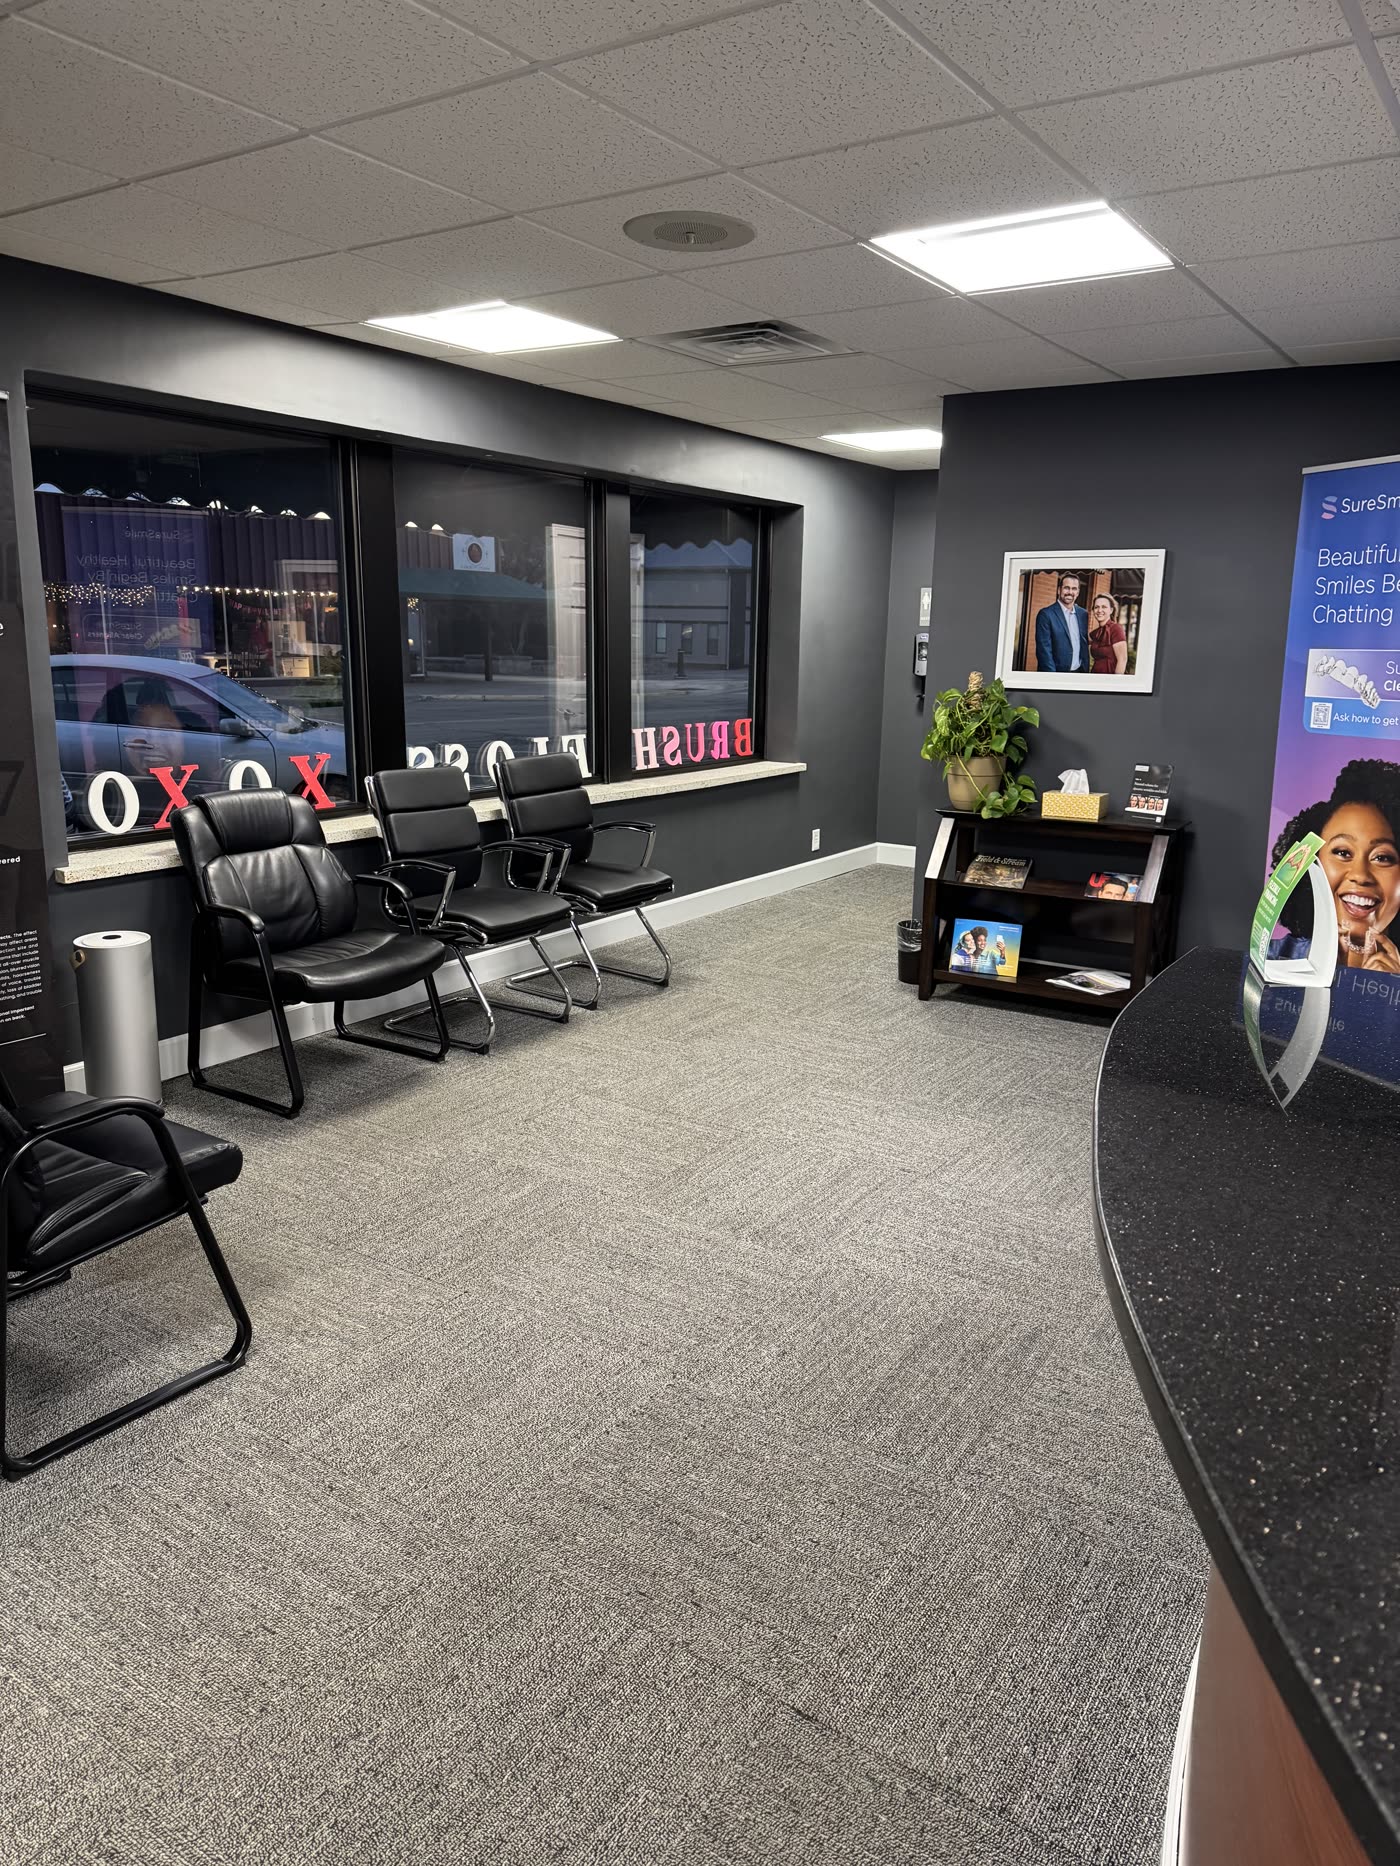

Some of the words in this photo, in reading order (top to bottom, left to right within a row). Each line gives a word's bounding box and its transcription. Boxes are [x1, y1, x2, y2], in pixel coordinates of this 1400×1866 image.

[1341, 494, 1400, 514] SureSm
[1314, 575, 1375, 595] Smiles
[1312, 604, 1393, 627] Chatting
[1333, 712, 1350, 722] Ask
[1351, 713, 1370, 723] how
[1371, 715, 1381, 724] to
[1382, 716, 1399, 727] get
[0, 855, 21, 865] ered
